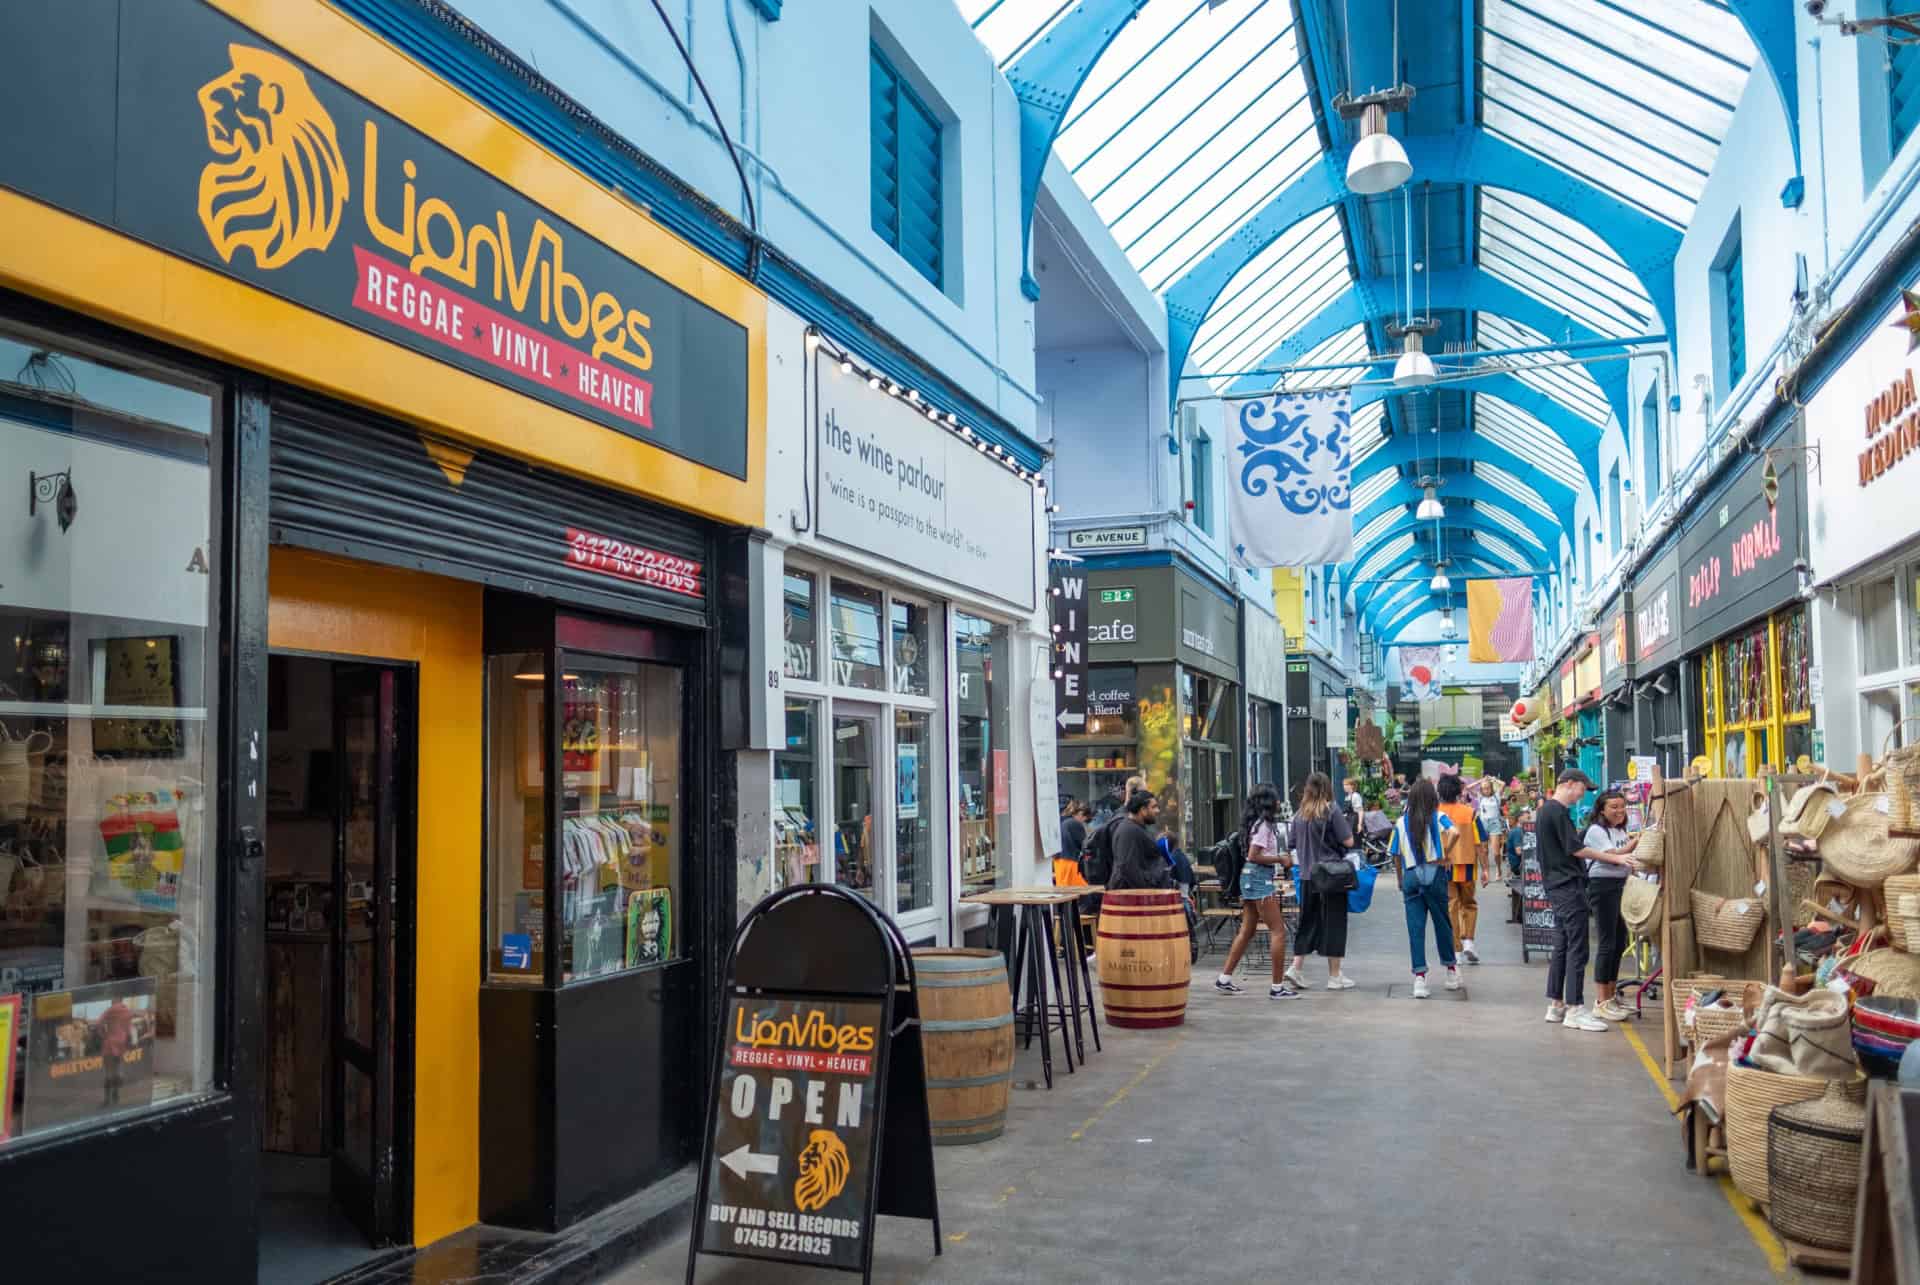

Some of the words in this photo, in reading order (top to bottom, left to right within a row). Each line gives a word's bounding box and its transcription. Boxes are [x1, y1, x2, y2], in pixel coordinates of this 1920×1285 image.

[363, 119, 653, 371] LionVibes
[367, 264, 464, 341] REGGAE
[491, 322, 552, 379] VINYL
[578, 361, 645, 417] HEAVEN
[1864, 368, 1918, 439] MODA
[825, 407, 852, 455] the
[857, 433, 893, 475] wine
[898, 456, 944, 501] parlour
[858, 488, 865, 508] is
[869, 498, 875, 513] a
[879, 502, 914, 528] passport
[916, 518, 924, 534] to
[926, 518, 937, 538] the
[1096, 532, 1139, 542] AVENUE
[1732, 506, 1780, 577] NORMAL
[1061, 577, 1083, 697] WINE
[1088, 619, 1134, 641] cafe
[768, 670, 779, 688] 89
[1100, 690, 1130, 701] coffee
[1095, 703, 1122, 715] Blend
[735, 1007, 875, 1055] LionVibes
[735, 1050, 775, 1065] REGGAE
[785, 1053, 816, 1068] VINYL
[827, 1057, 867, 1072] HEAVEN
[730, 1073, 864, 1128] OPEN
[710, 1204, 738, 1223] BUY
[738, 1207, 766, 1226] AND
[768, 1211, 796, 1231] SELL
[798, 1214, 859, 1239] RECORDS
[734, 1227, 777, 1249] 07459
[779, 1233, 832, 1256] 221925
